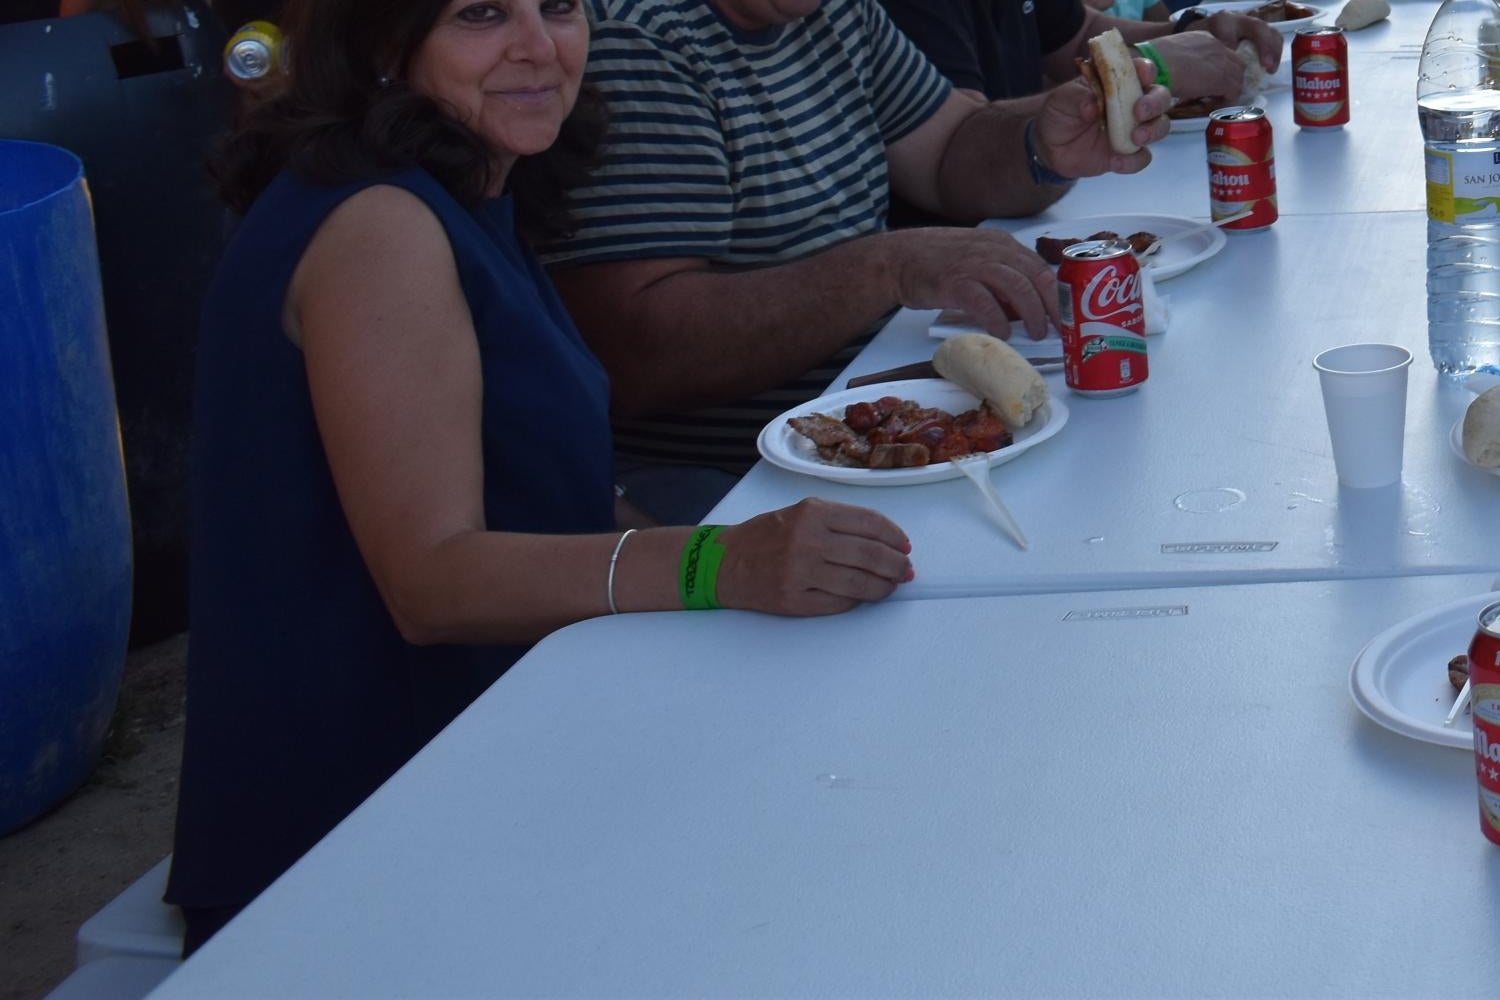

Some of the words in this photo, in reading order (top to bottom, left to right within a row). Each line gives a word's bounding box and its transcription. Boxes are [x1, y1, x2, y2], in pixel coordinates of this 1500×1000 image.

[1295, 75, 1341, 90] Mahou
[1209, 170, 1250, 186] ahou
[1464, 175, 1485, 185] SAN
[1081, 265, 1144, 320] Coca
